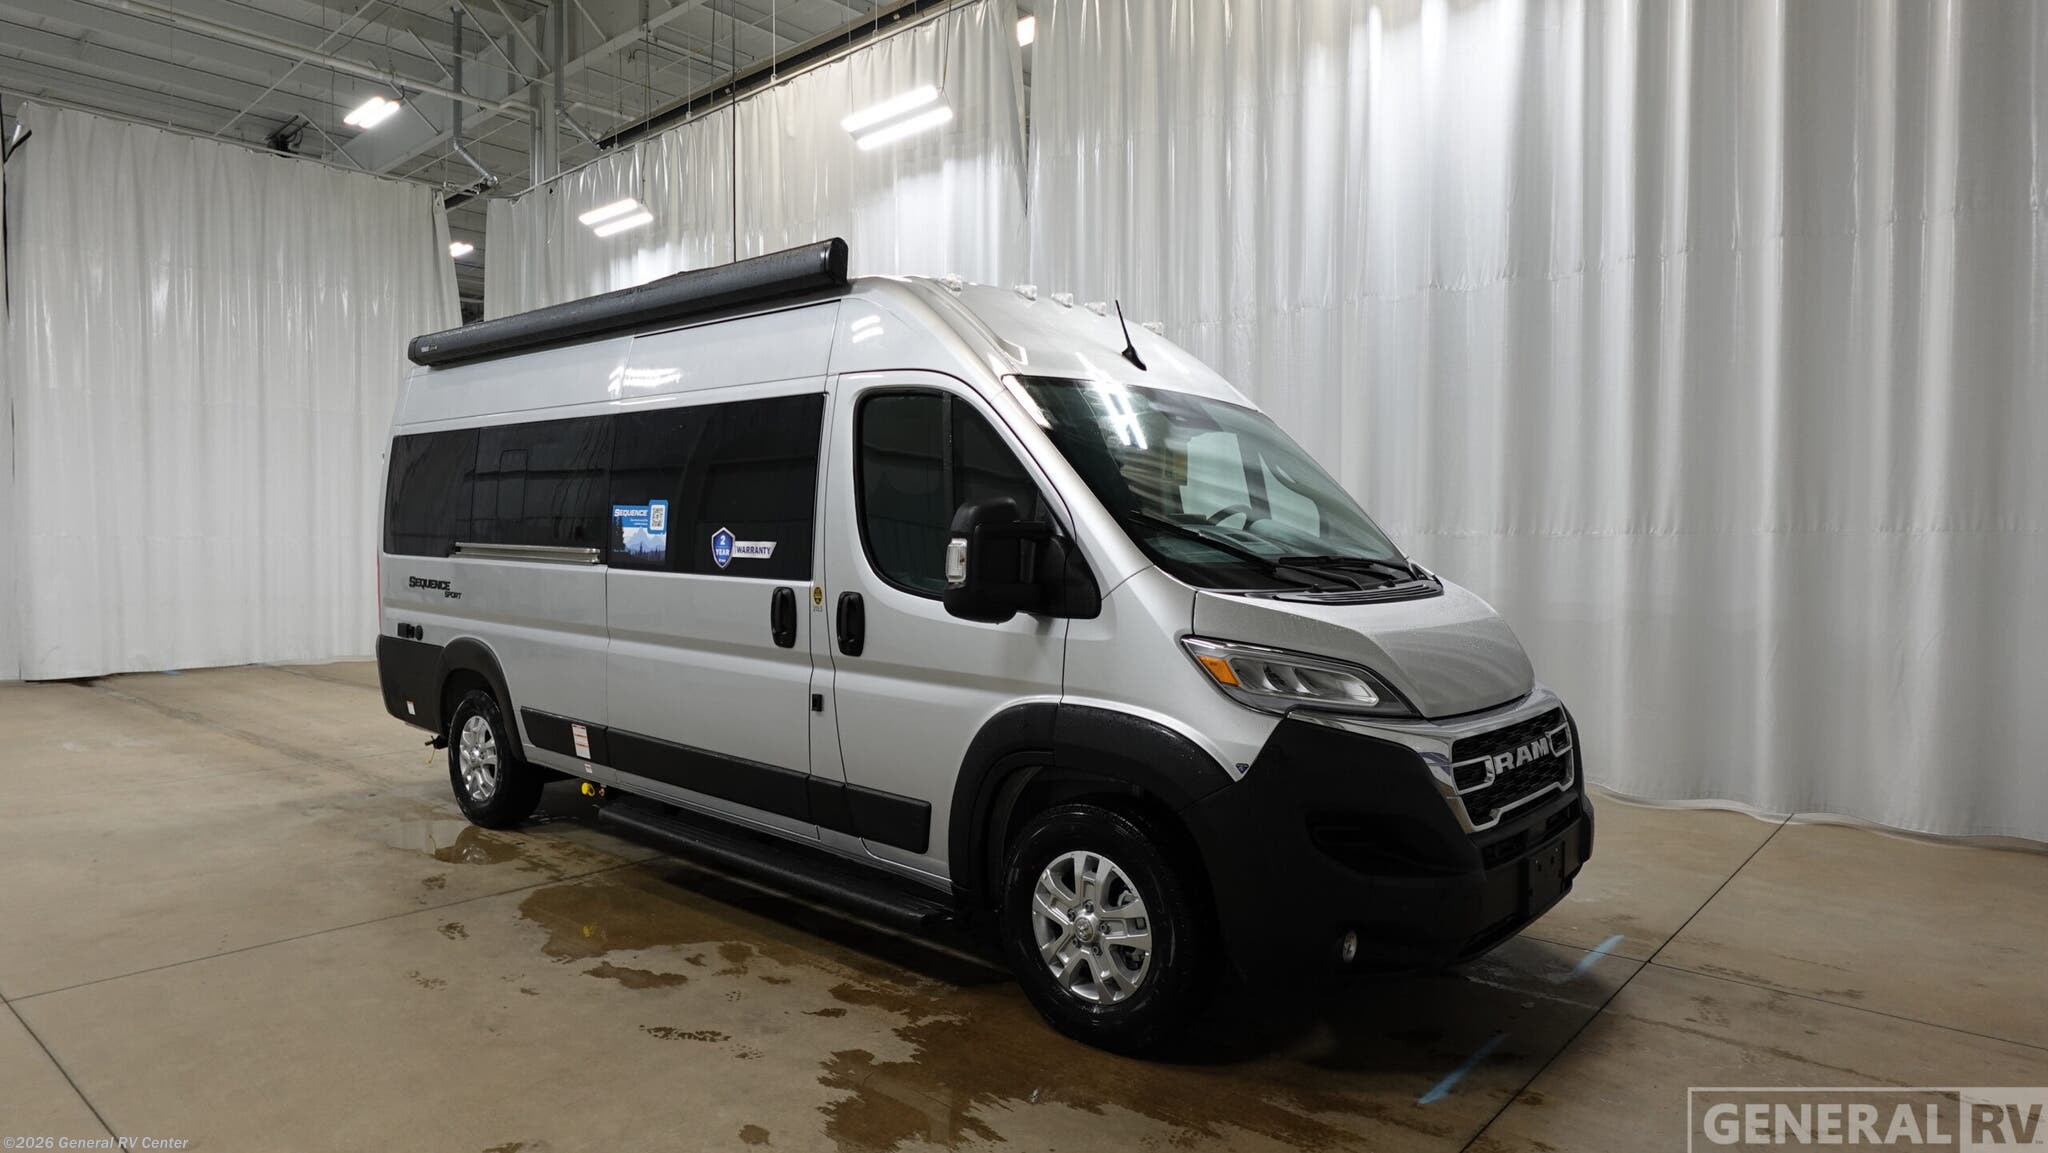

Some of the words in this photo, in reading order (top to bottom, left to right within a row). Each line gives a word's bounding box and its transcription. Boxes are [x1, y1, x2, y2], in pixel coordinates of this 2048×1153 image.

[614, 508, 649, 517] SEQUENCE
[720, 535, 726, 546] 2
[715, 548, 730, 556] YEAR
[736, 545, 771, 554] WARRANTY
[409, 576, 451, 591] SEQUENCE
[444, 591, 462, 599] SPORT
[1493, 737, 1550, 775] RAM
